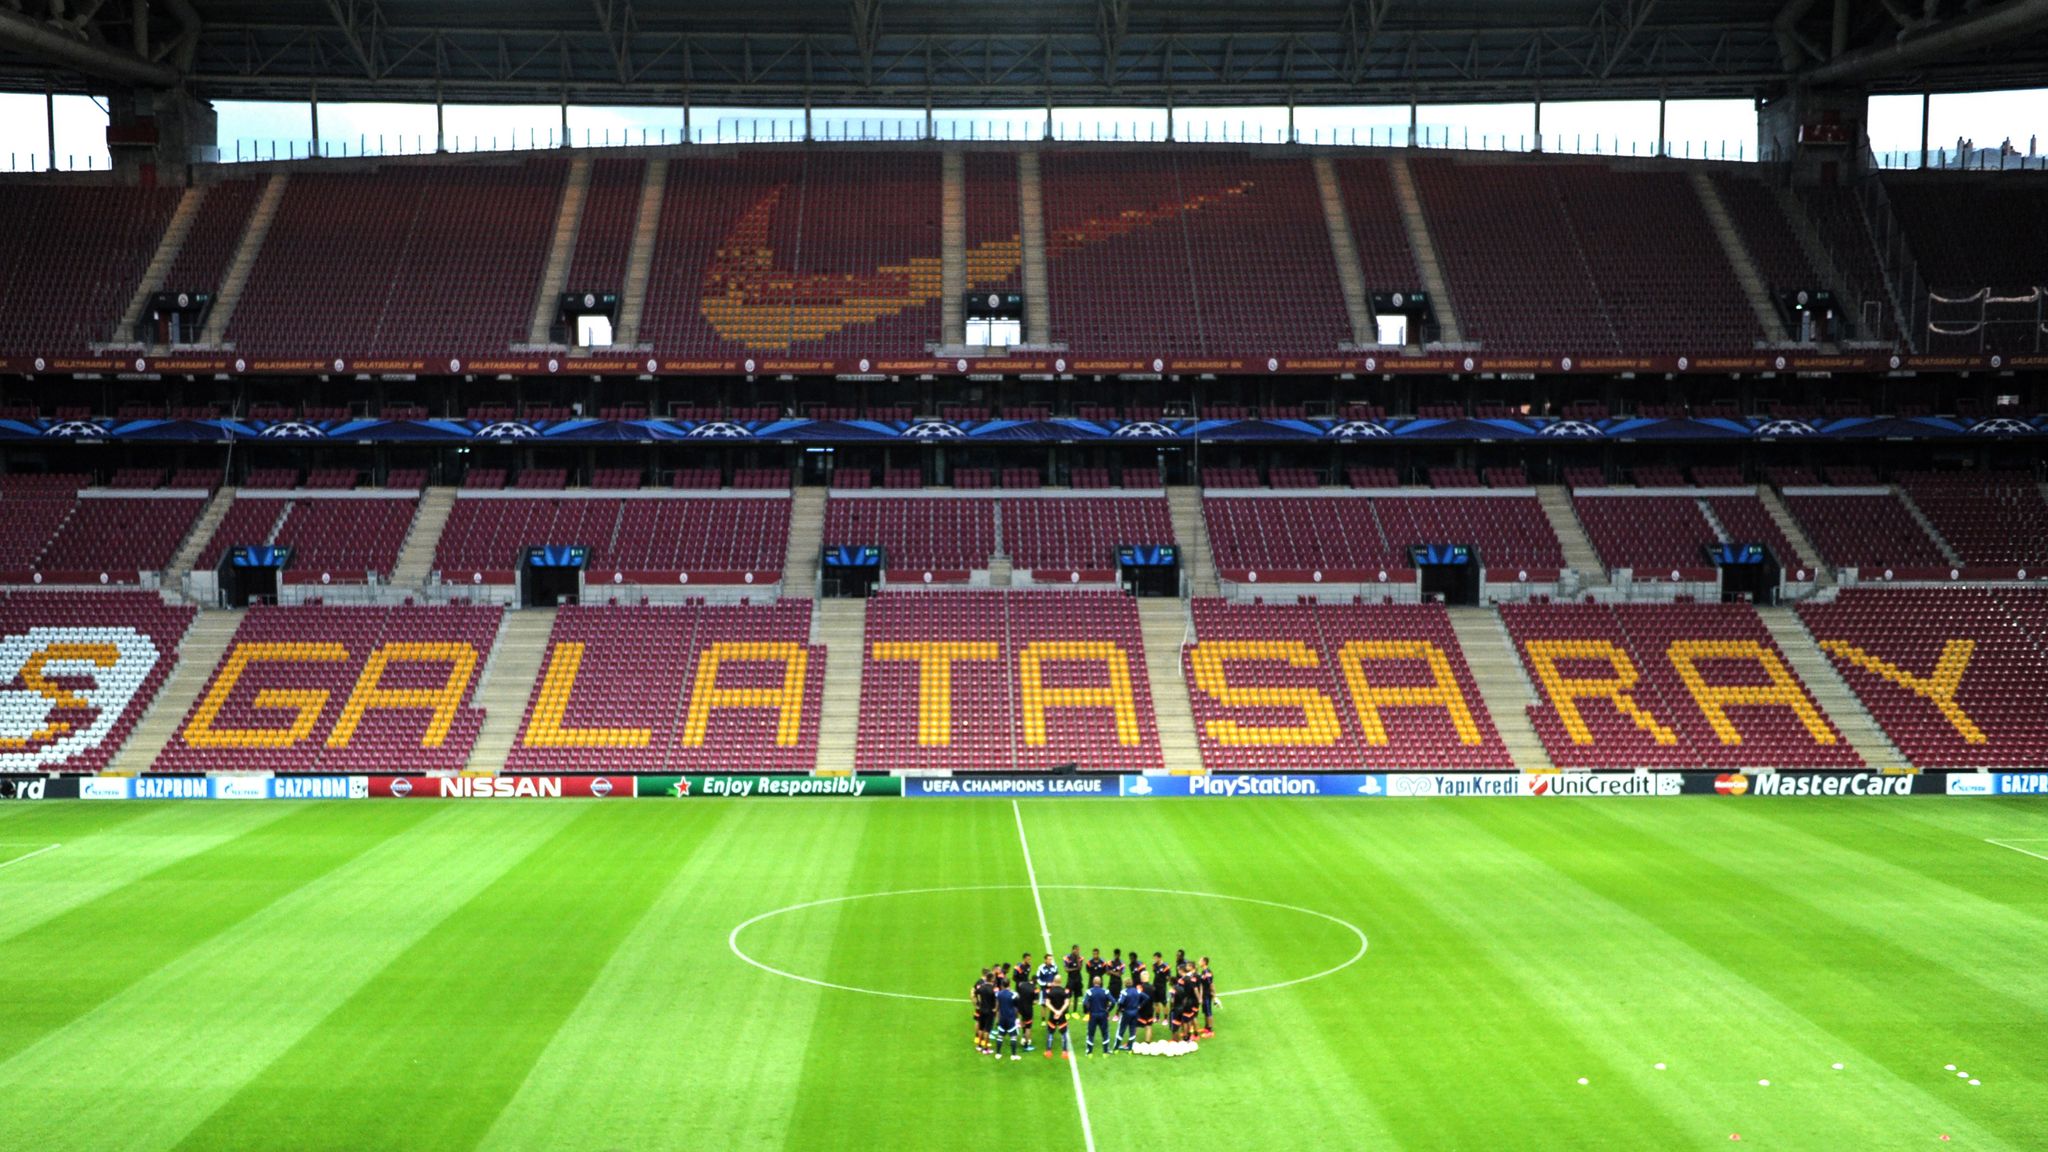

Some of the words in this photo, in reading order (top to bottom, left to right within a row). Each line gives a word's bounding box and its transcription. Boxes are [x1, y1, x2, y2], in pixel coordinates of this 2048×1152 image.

[183, 642, 1987, 747] GALATASARAY
[136, 778, 207, 797] GAZPROM
[275, 778, 346, 797] GAZPROM
[441, 777, 562, 797] NISSAN
[703, 776, 754, 796] Enjoy
[758, 776, 866, 797] Responsibly
[923, 780, 959, 793] UEFA
[962, 780, 1044, 793] CHAMPIONS
[1048, 780, 1102, 793] LEAGUE
[1190, 776, 1315, 796] PlayStation
[1552, 775, 1650, 795] UniCredit
[1754, 773, 1914, 795] MasterCard
